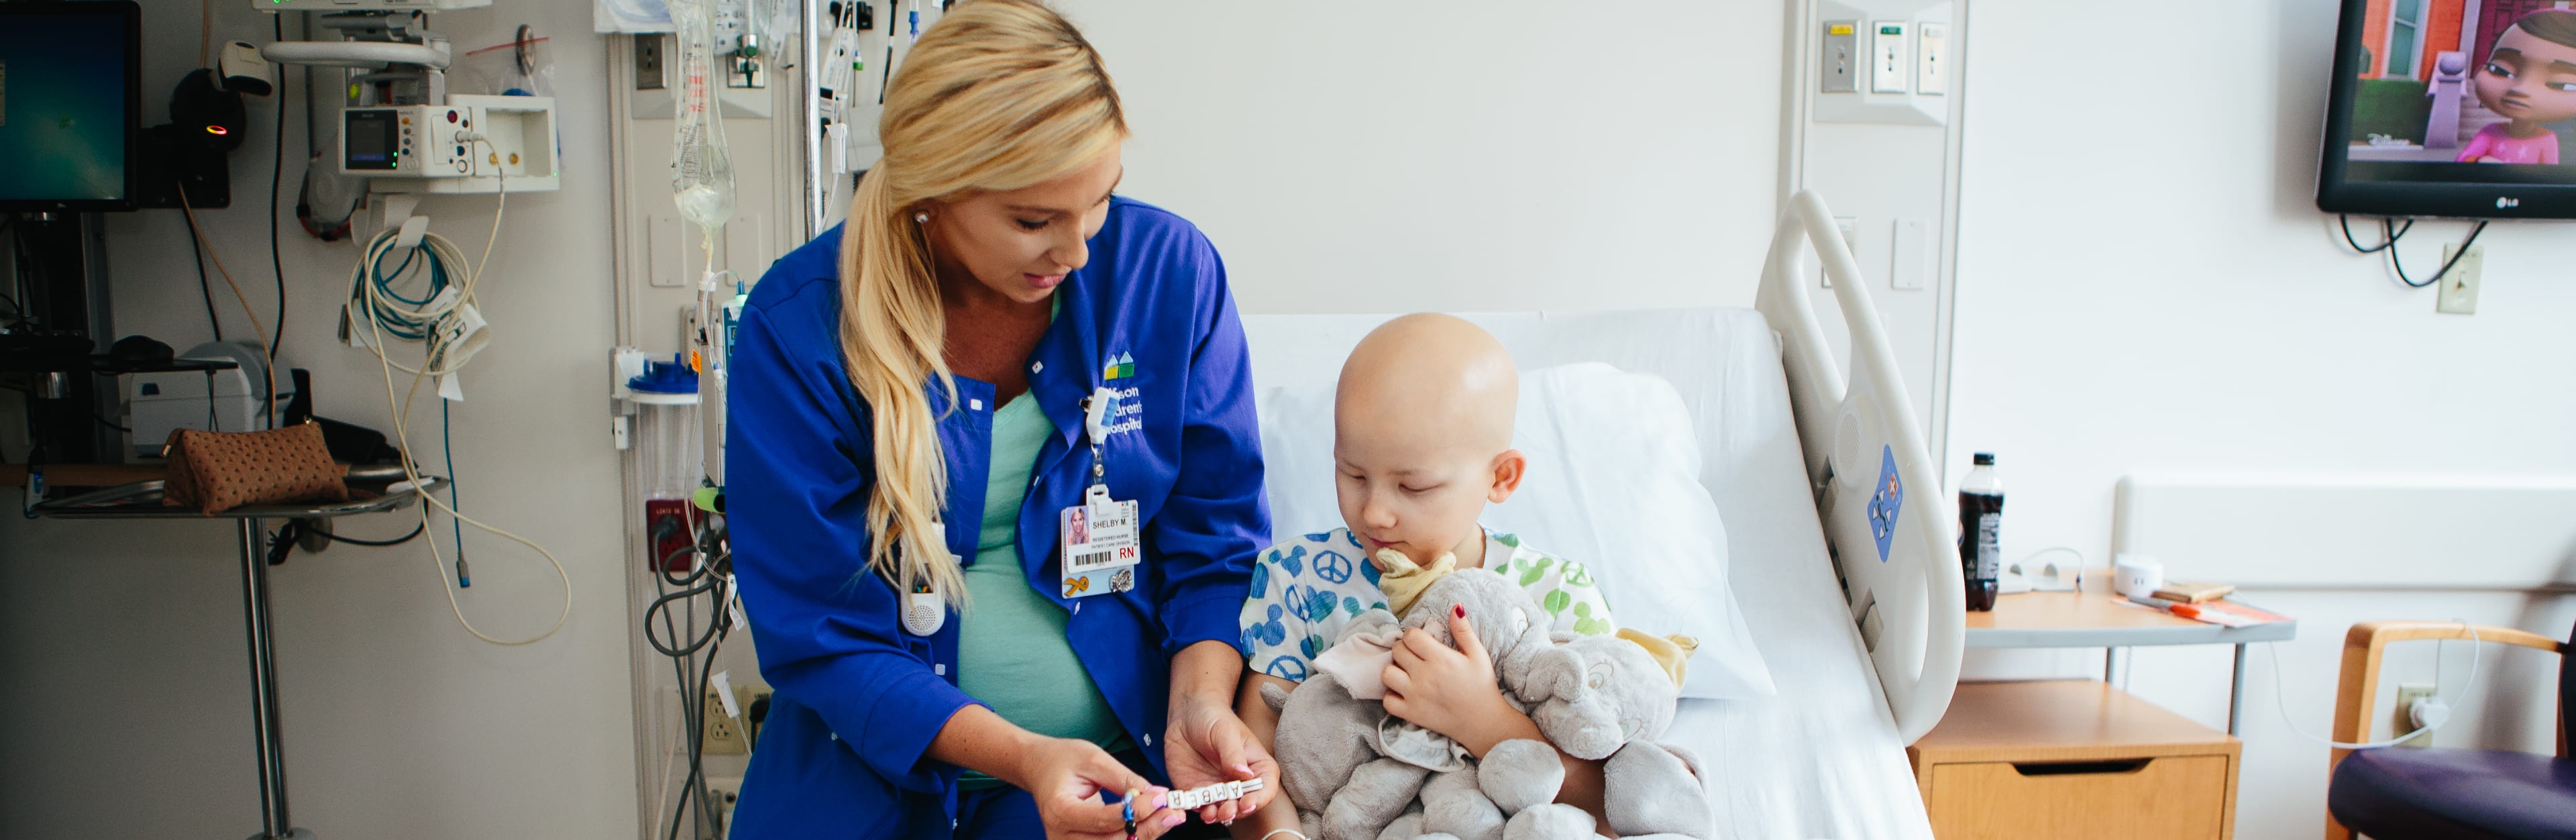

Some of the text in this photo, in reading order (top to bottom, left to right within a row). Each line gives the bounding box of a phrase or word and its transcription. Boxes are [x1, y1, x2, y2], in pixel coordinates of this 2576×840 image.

[1115, 400, 1142, 417] dren's
[1093, 519, 1119, 529] SHELBY
[1120, 547, 1134, 559] RN
[1173, 784, 1240, 807] AMBER
